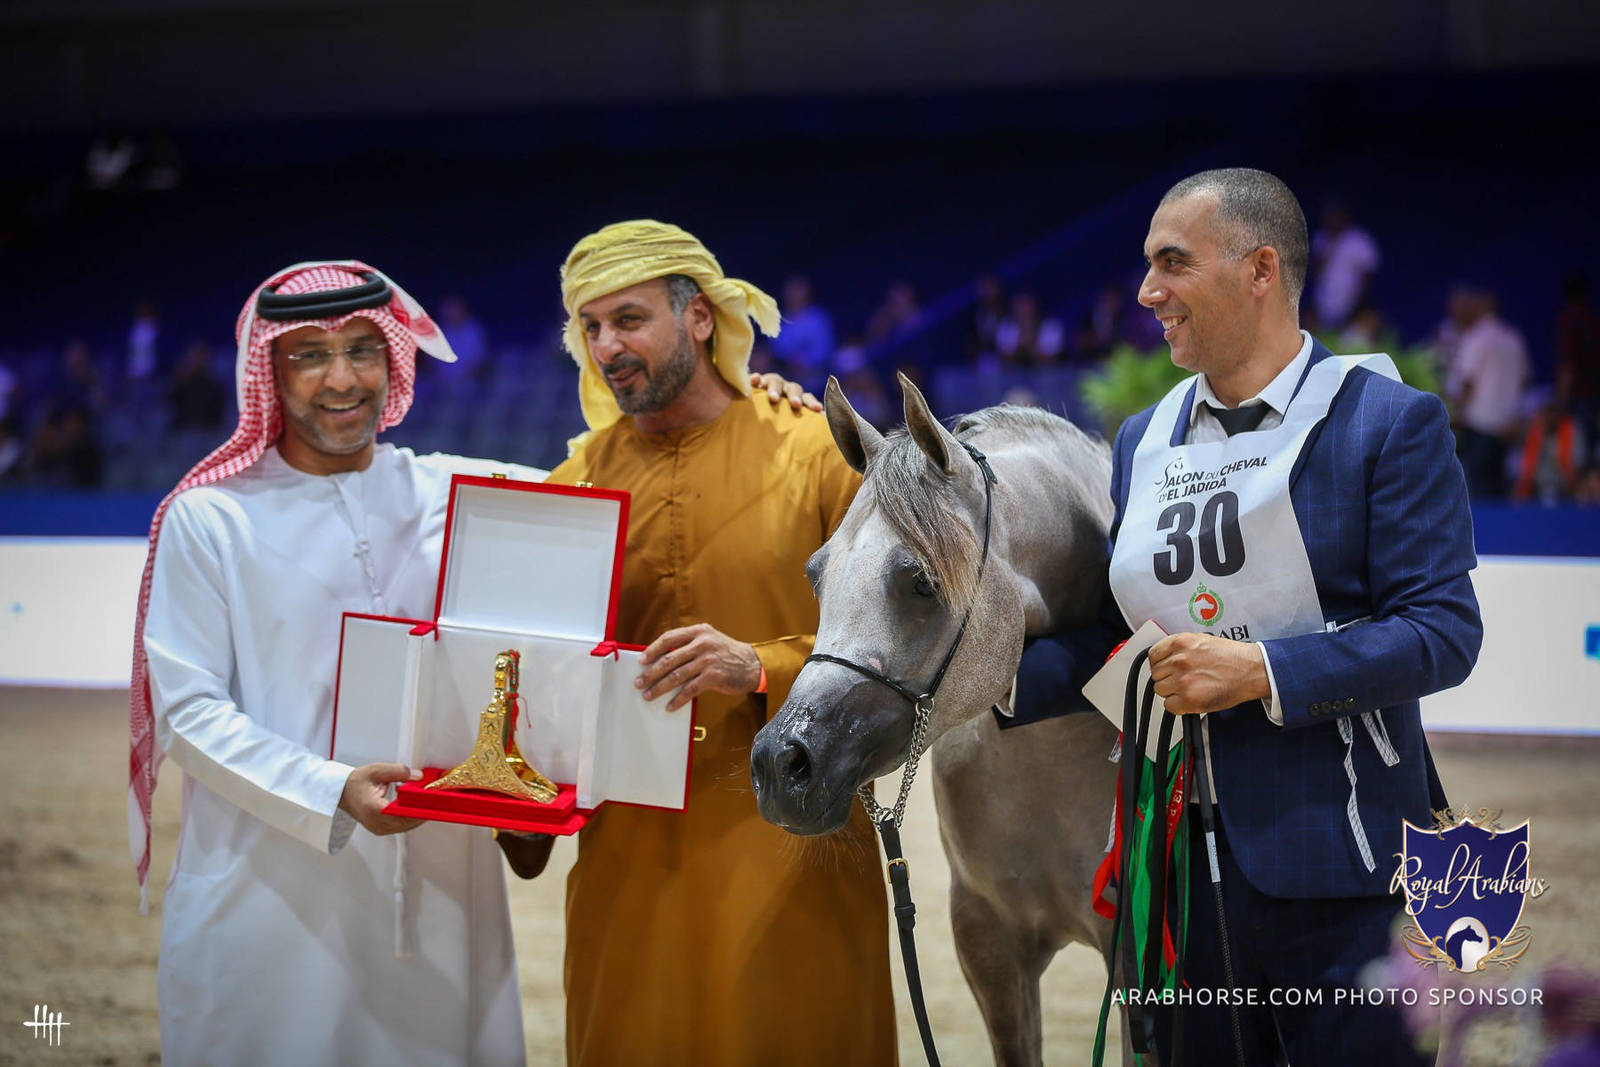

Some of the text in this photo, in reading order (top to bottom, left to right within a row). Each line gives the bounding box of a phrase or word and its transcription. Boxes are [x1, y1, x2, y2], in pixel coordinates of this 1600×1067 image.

[1205, 470, 1220, 481] DU
[1220, 456, 1268, 477] CHEVAL
[1182, 477, 1227, 498] JADIDA
[1153, 490, 1246, 586] 30
